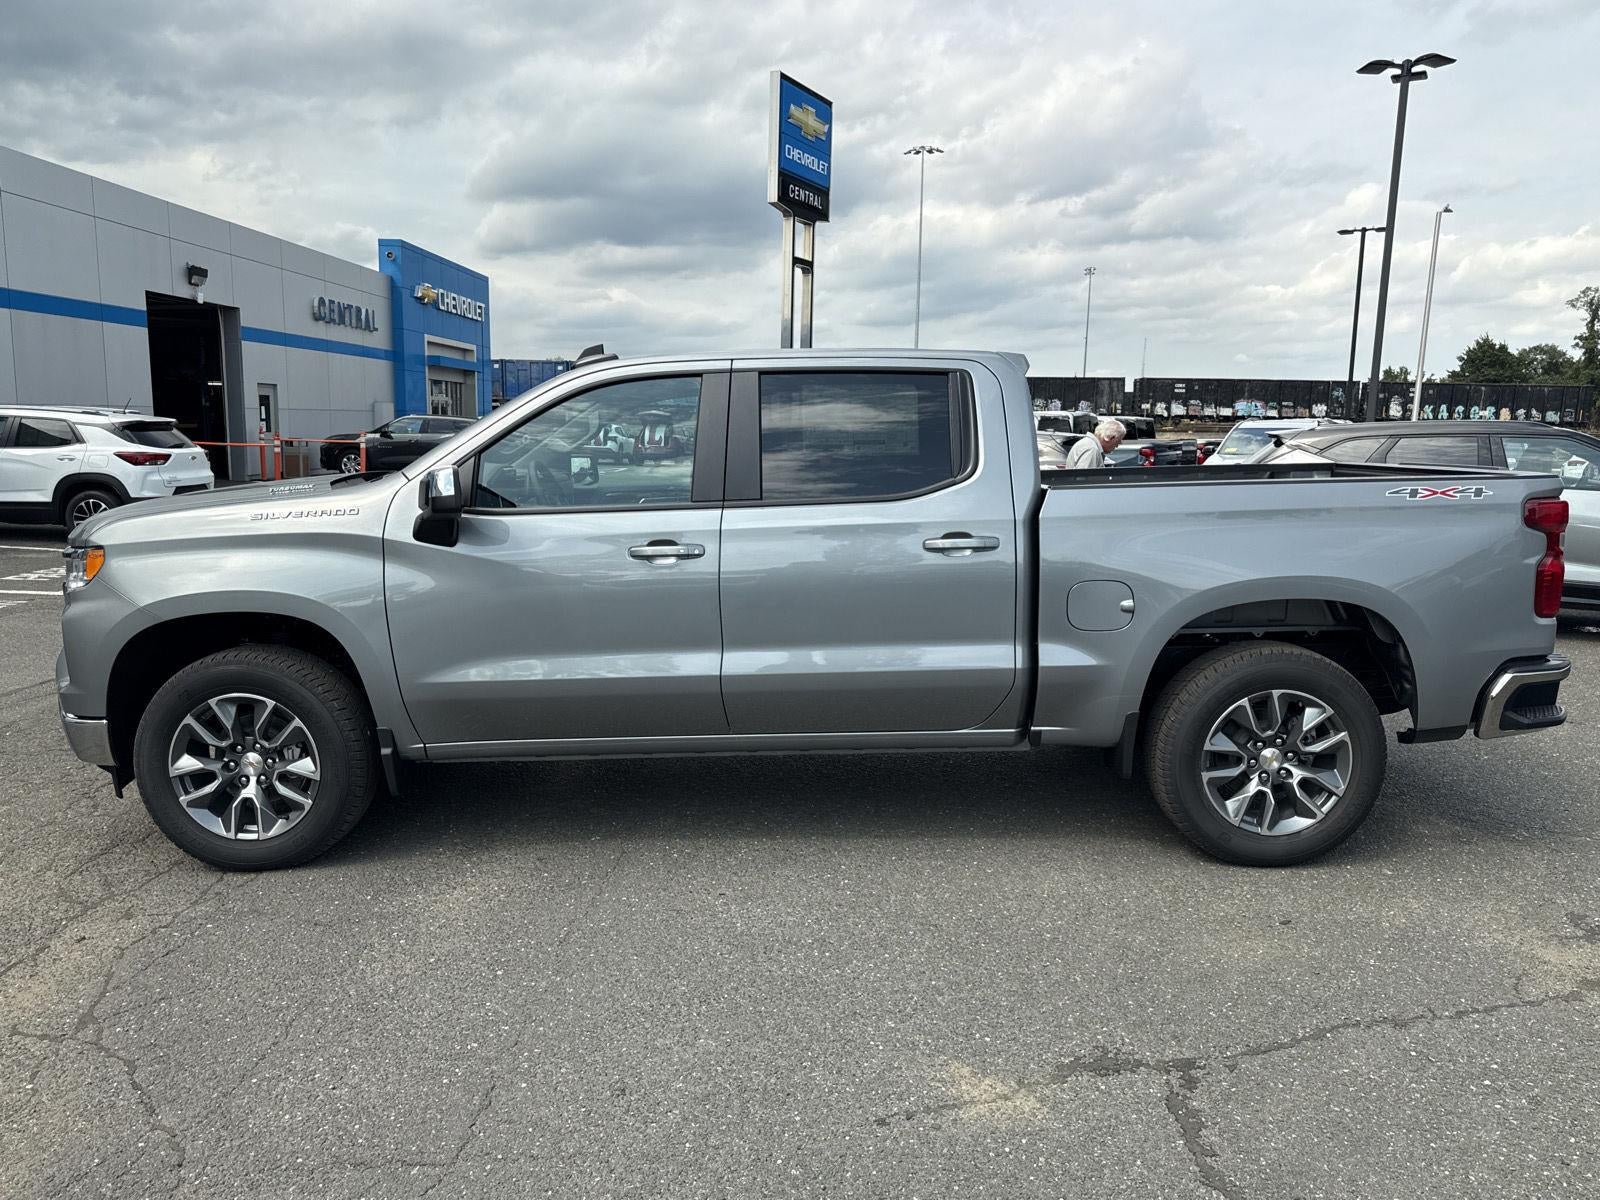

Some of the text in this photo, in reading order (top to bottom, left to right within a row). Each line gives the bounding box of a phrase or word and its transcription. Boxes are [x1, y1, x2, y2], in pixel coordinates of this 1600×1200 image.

[785, 144, 829, 175] CHEVROLET
[788, 184, 823, 209] CENTRAL
[312, 296, 379, 333] CENTRAL
[438, 288, 486, 322] CHEVROLET
[249, 506, 361, 521] SILVERADO
